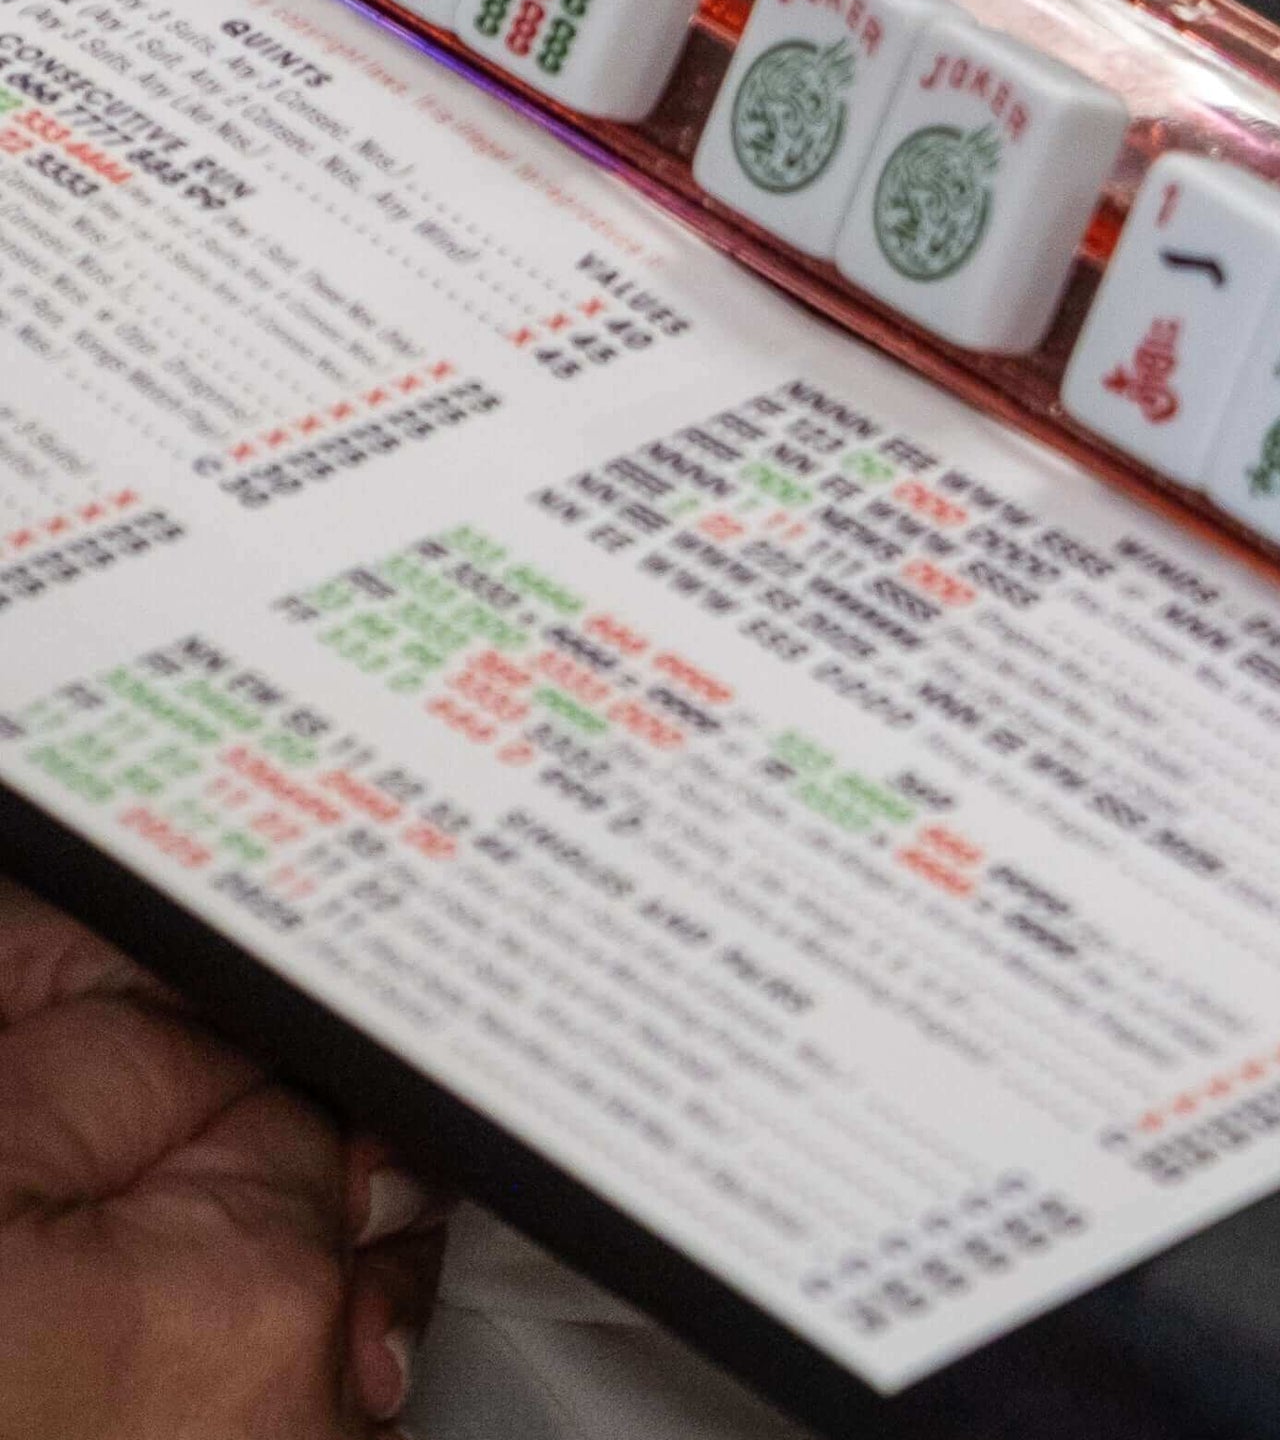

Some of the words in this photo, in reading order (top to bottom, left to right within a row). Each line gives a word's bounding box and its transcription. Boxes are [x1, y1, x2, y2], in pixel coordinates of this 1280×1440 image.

[221, 19, 333, 88] QUINTS
[575, 251, 691, 336] VALUES
[920, 54, 1031, 140] JOKER
